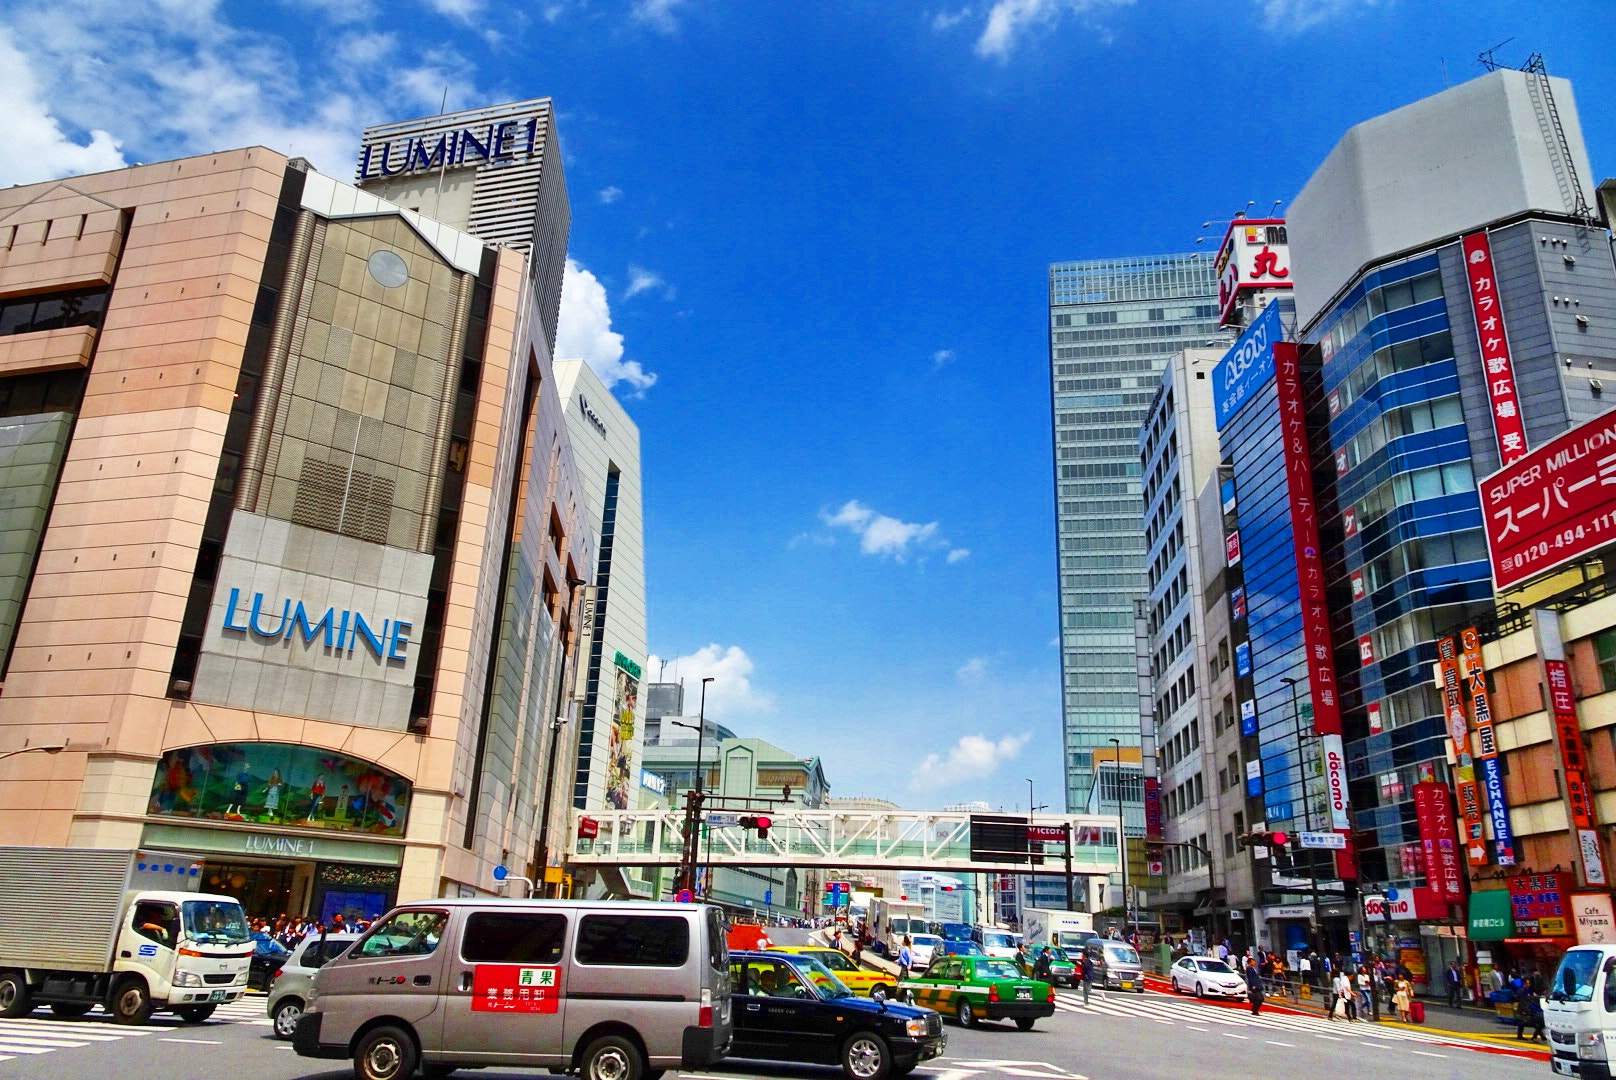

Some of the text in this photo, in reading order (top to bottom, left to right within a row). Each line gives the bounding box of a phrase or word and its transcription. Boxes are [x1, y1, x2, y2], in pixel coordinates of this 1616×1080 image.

[361, 119, 538, 180] LUMINE 1
[1475, 276, 1516, 419] カラオケ歌広場
[1490, 424, 1616, 505] SUPER MILLION
[223, 587, 413, 661] LUMINE
[583, 599, 594, 630] LUMINE
[1469, 662, 1496, 756] 大黒屋
[1550, 669, 1571, 710] 指圧
[1328, 751, 1343, 811] docomo
[1486, 760, 1508, 840] EXCHANGE
[246, 836, 314, 853] LUMINE 1
[1433, 788, 1460, 894] カラオケ 歌広場
[1579, 918, 1609, 927] Miyama
[1584, 907, 1600, 915] Cafe
[522, 970, 552, 985] 青果
